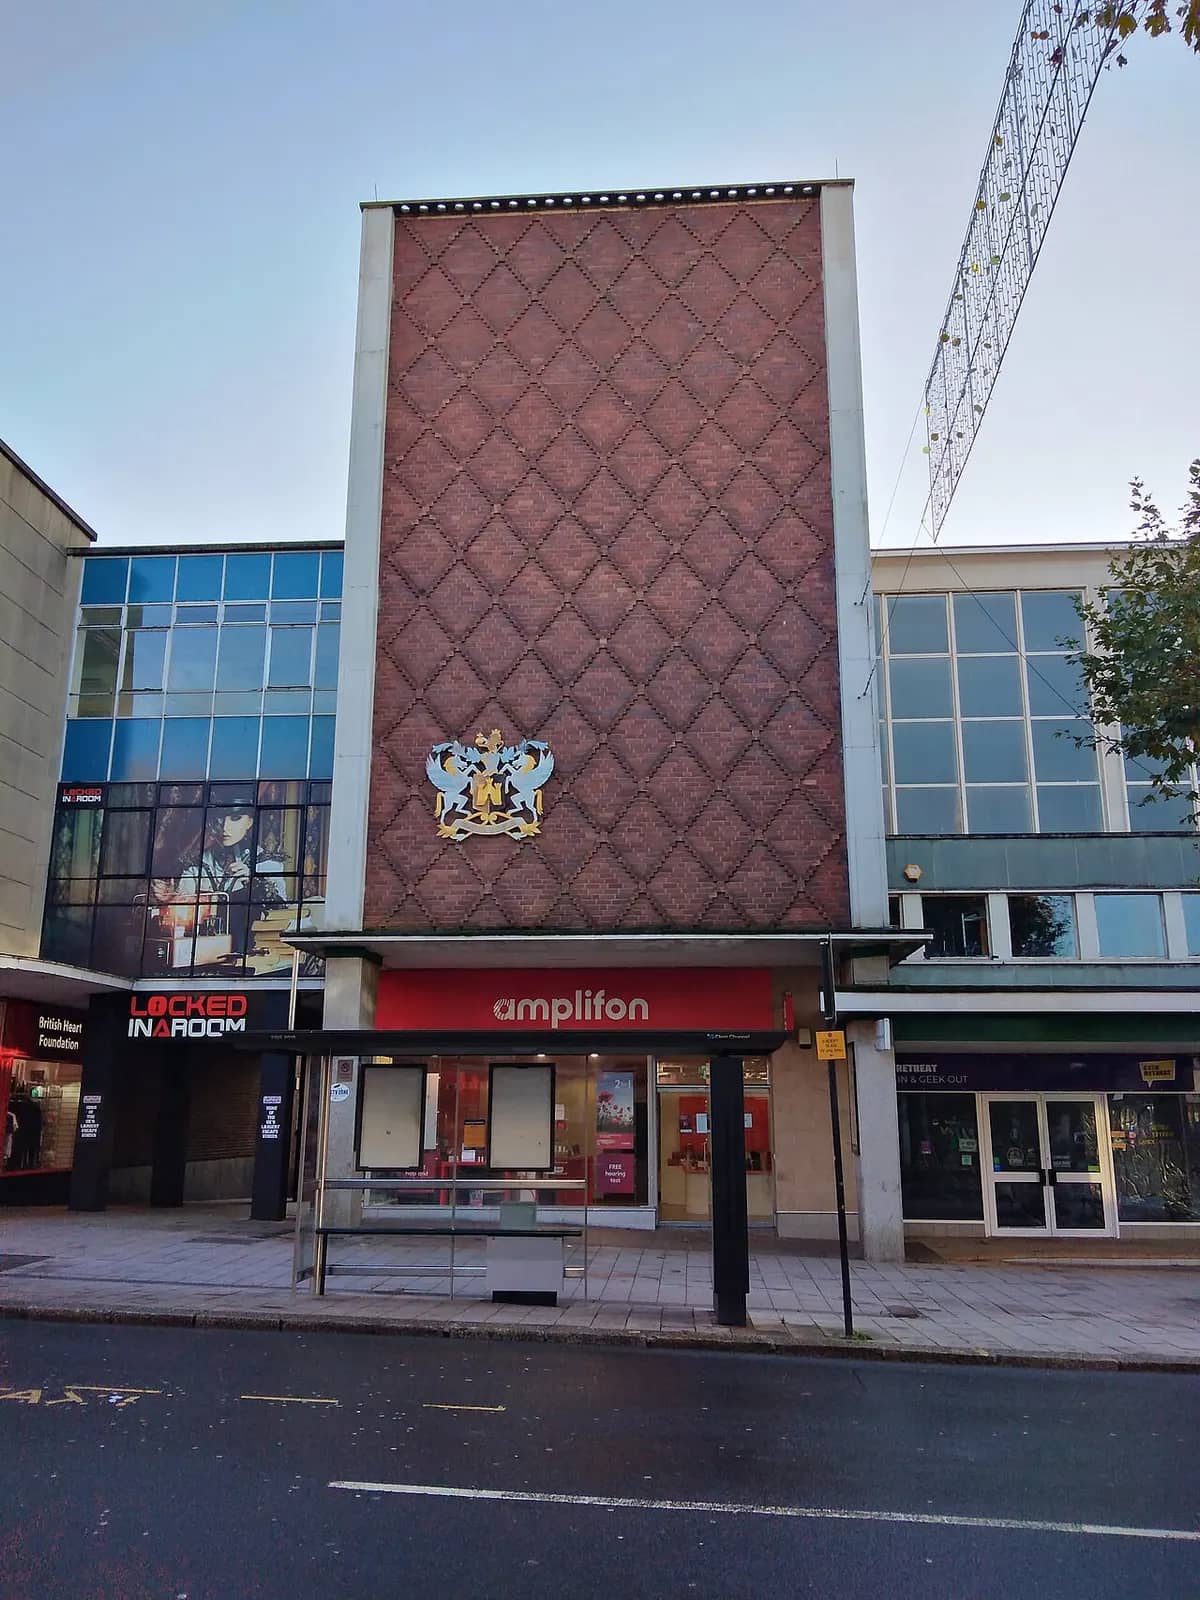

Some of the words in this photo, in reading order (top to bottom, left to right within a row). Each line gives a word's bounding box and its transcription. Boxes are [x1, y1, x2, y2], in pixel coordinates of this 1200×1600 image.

[63, 788, 102, 796] LOCKED
[130, 995, 248, 1017] LOCKED
[492, 988, 649, 1029] amplifon
[38, 1015, 62, 1031] British
[62, 1019, 82, 1034] Heart
[38, 1034, 79, 1050] Foundation
[895, 1064, 938, 1073] RETREAT
[919, 1075, 945, 1084] GEEK
[947, 1075, 969, 1084] OUT
[604, 1170, 626, 1178] hearing
